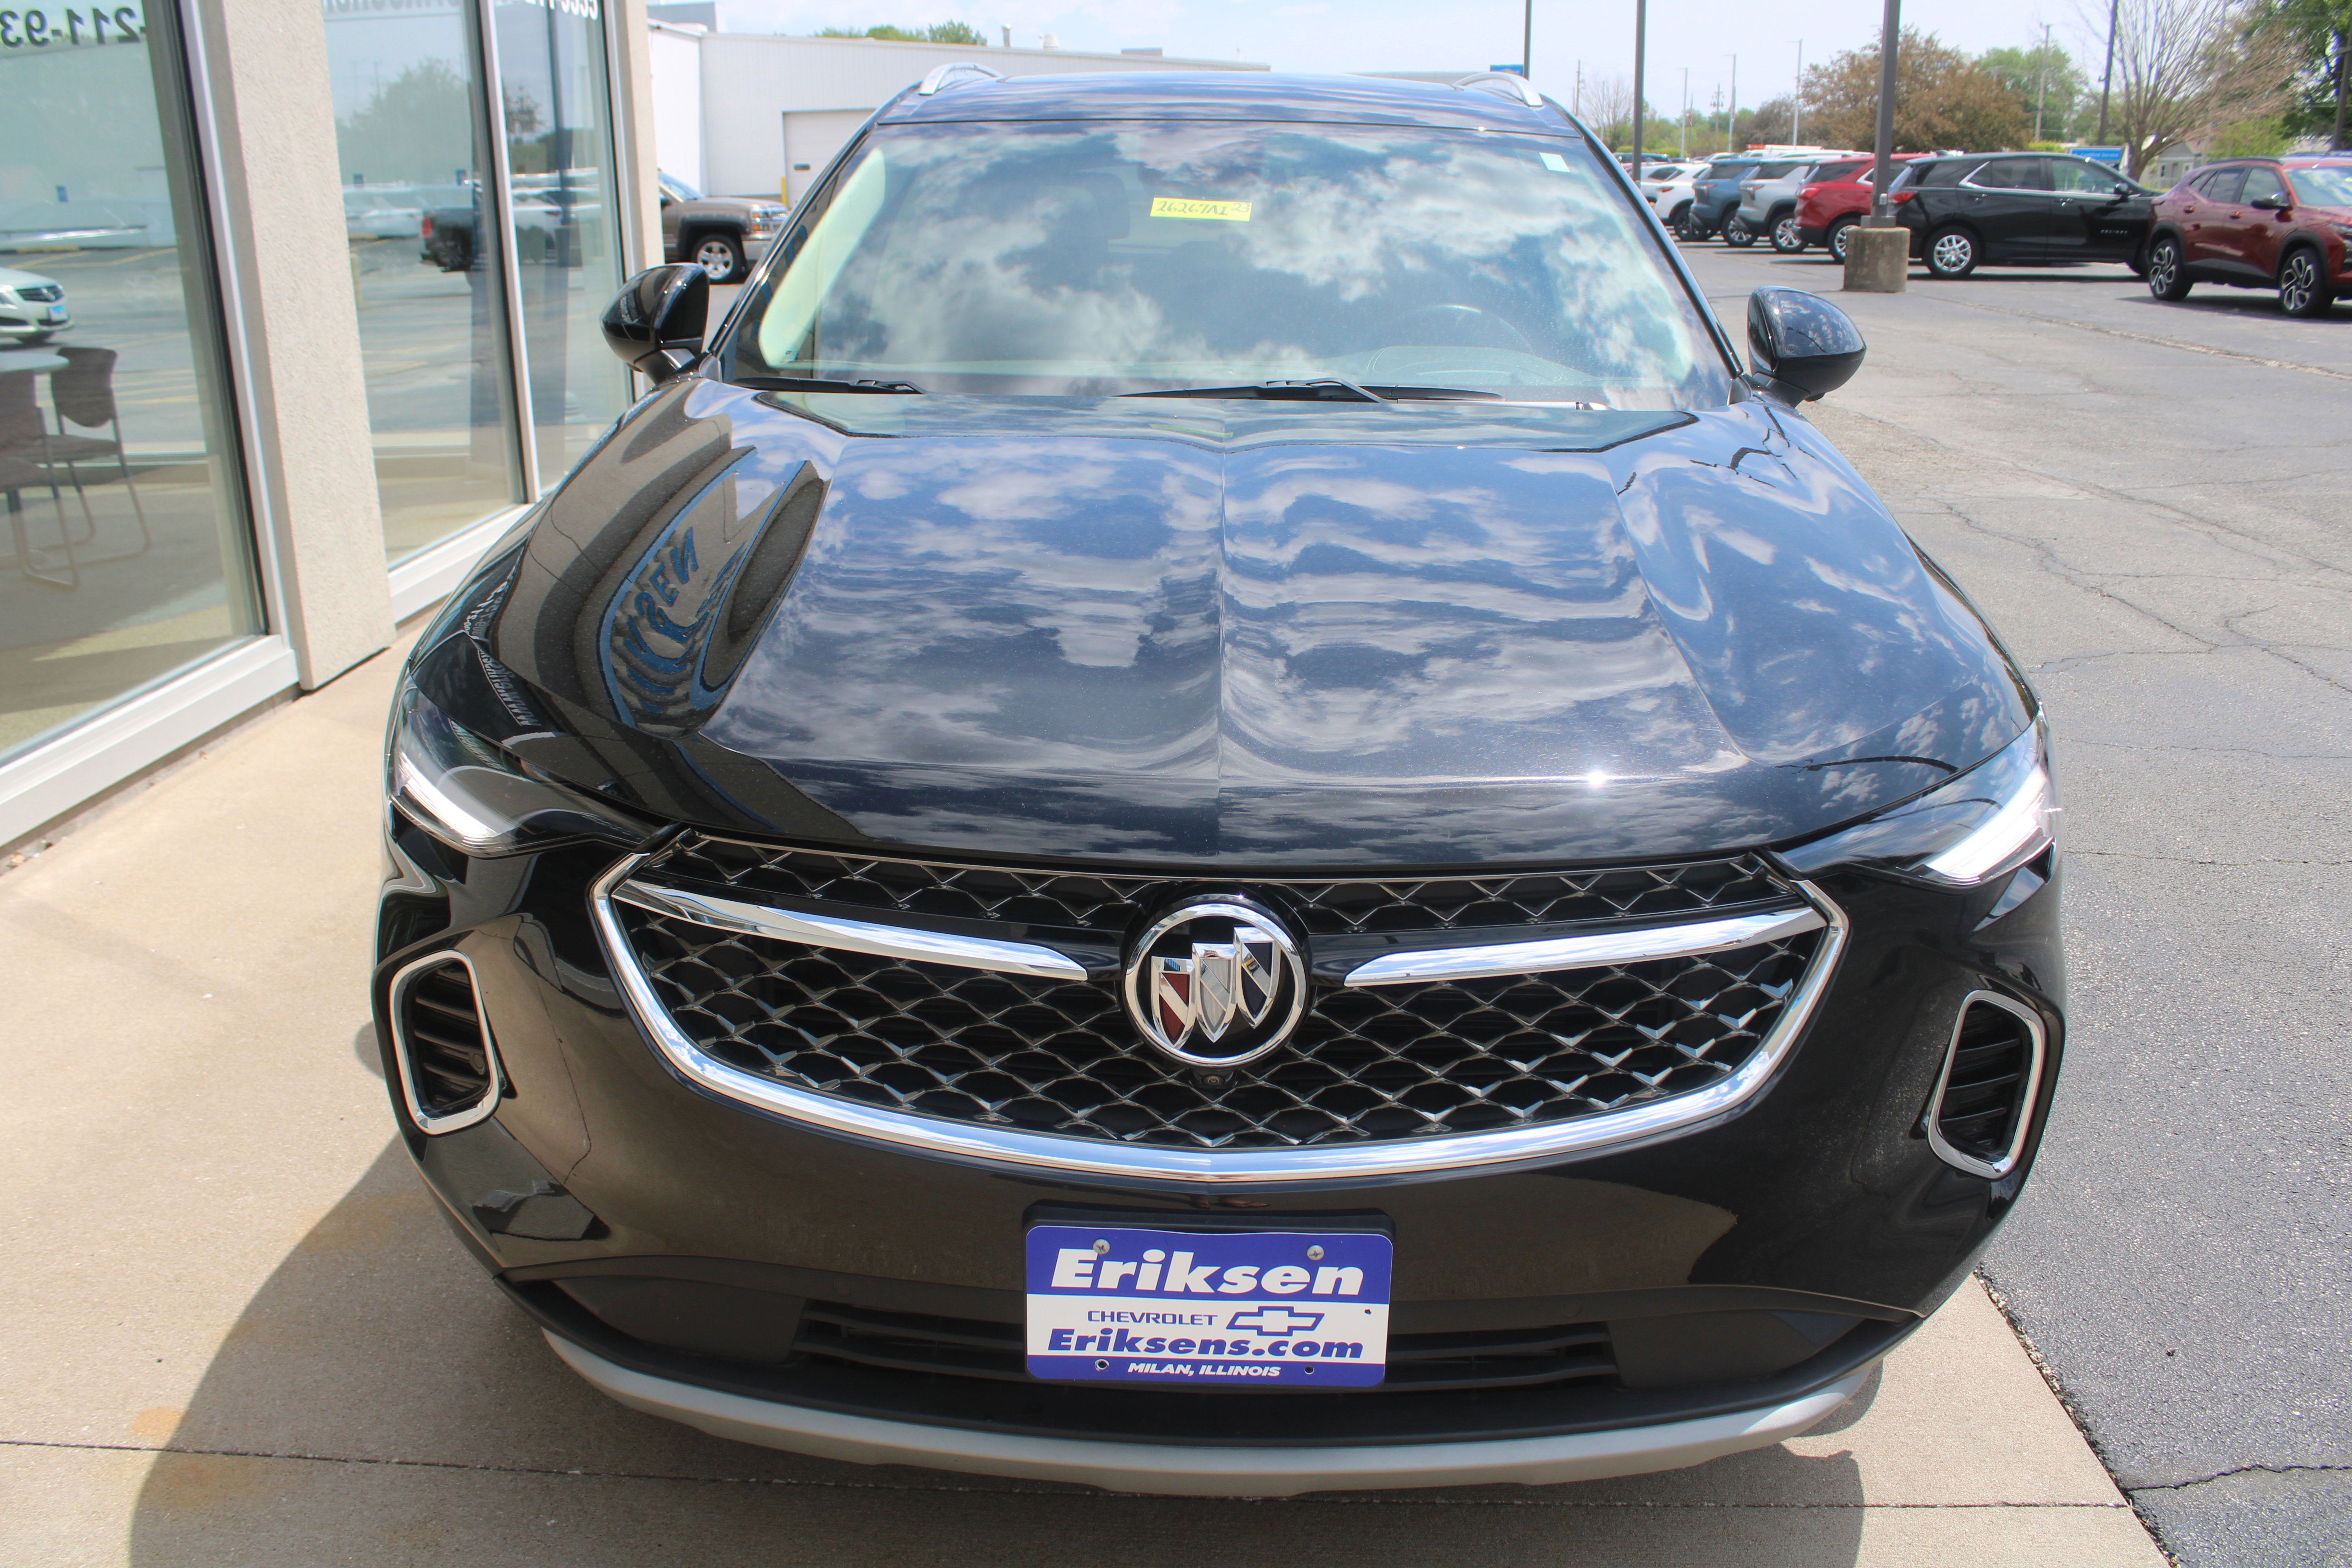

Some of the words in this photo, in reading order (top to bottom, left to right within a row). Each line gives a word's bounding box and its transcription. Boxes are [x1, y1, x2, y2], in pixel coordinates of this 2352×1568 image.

[1051, 1248, 1363, 1295] Eriksen
[1088, 1311, 1218, 1325] CHEVROLET
[1048, 1328, 1363, 1359] Eriksens.com
[1127, 1363, 1194, 1376] MILAN,
[1199, 1365, 1281, 1376] ILLINOIS
